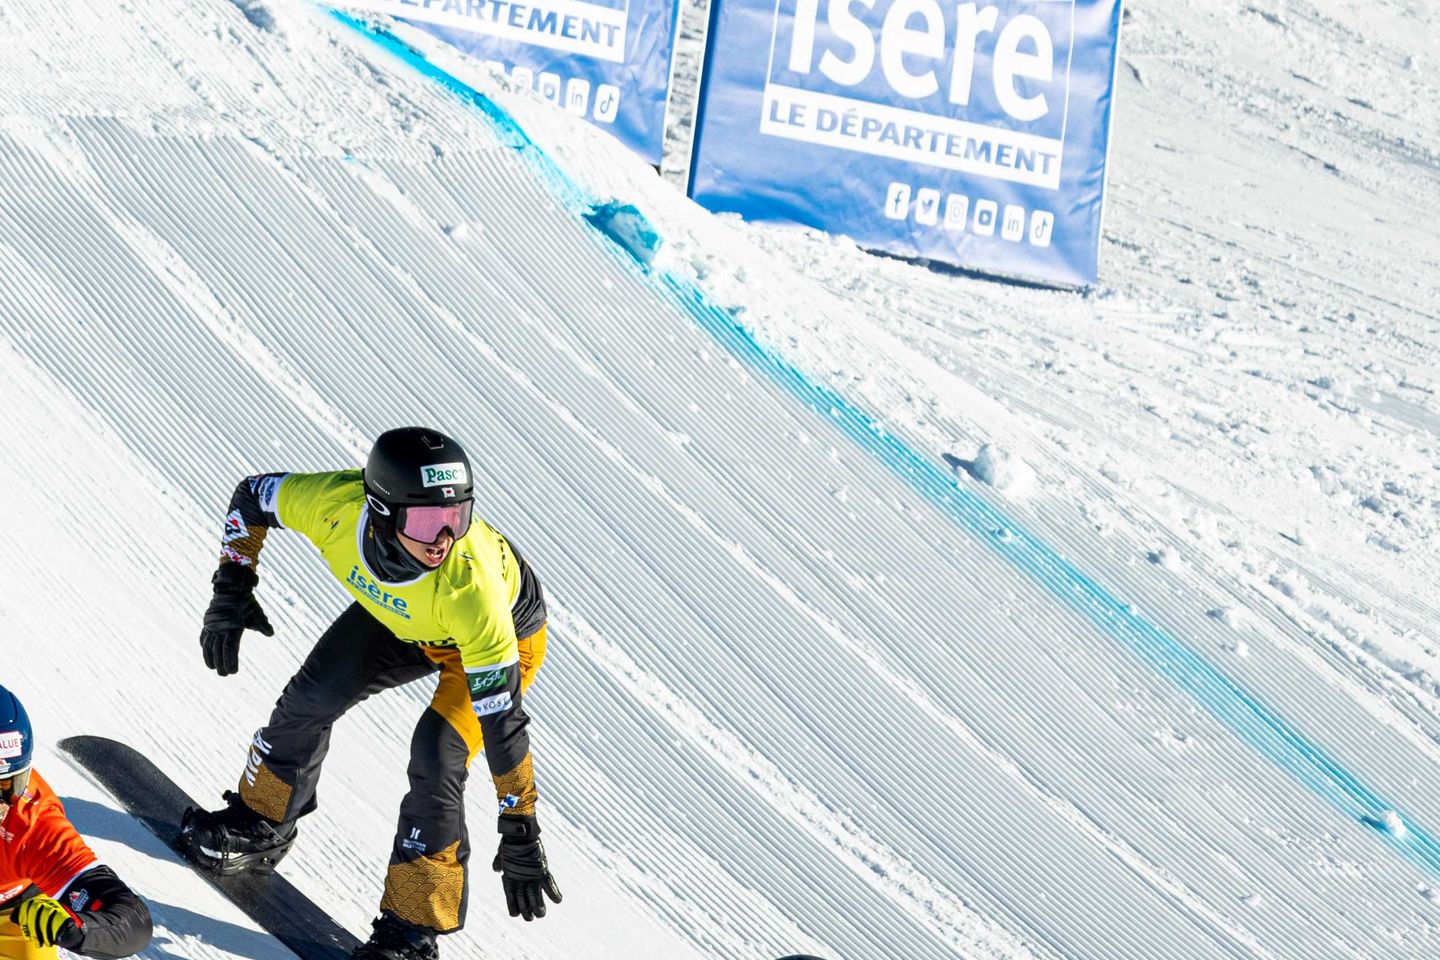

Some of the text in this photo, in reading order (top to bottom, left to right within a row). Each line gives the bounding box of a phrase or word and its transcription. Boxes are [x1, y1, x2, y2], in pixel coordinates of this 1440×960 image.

[401, 0, 621, 47] ARTEMENT
[768, 99, 1058, 175] LE DÉPARTEMENT
[349, 565, 408, 612] isère
